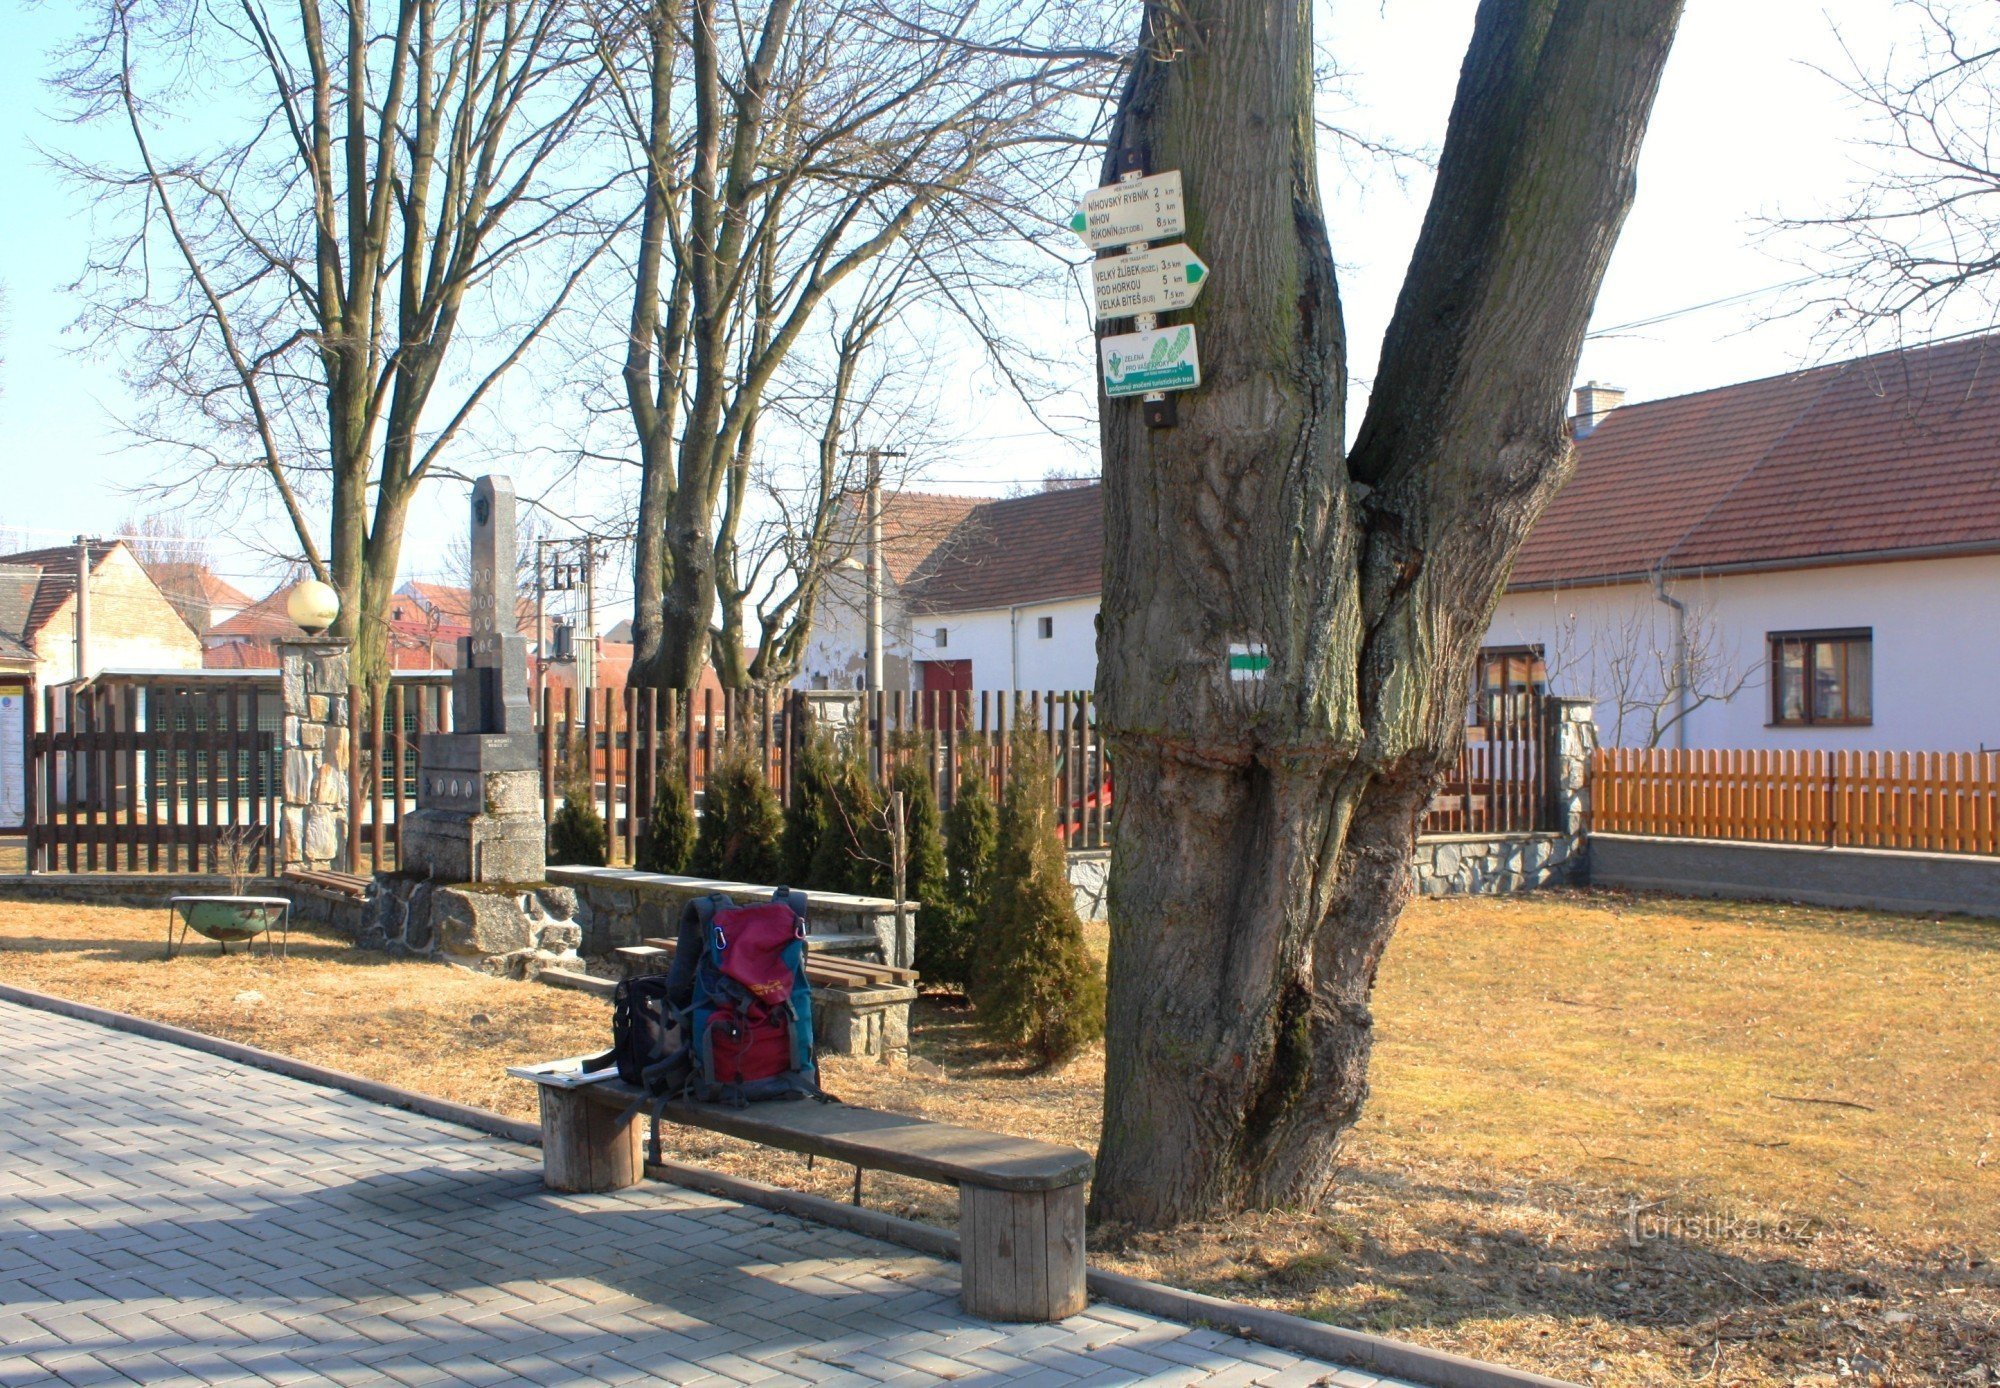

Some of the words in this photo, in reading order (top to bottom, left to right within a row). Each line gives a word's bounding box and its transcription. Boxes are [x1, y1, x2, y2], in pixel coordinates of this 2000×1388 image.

[1088, 196, 1122, 212] NÍHOVSKÝ
[1124, 189, 1149, 204] RYBNÍK
[1154, 188, 1159, 198] 2
[1090, 213, 1110, 226] NÍHOV
[1155, 202, 1160, 212] 3
[1168, 218, 1176, 226] km
[1095, 268, 1116, 282] VELKÝ
[1117, 264, 1140, 278] ŽLÍBEK
[1097, 286, 1110, 296] POD
[1113, 280, 1141, 293] HORKOU
[1163, 275, 1167, 284] 5
[1098, 296, 1120, 310] VELKÁ
[1122, 292, 1141, 307] BÍTEŠ
